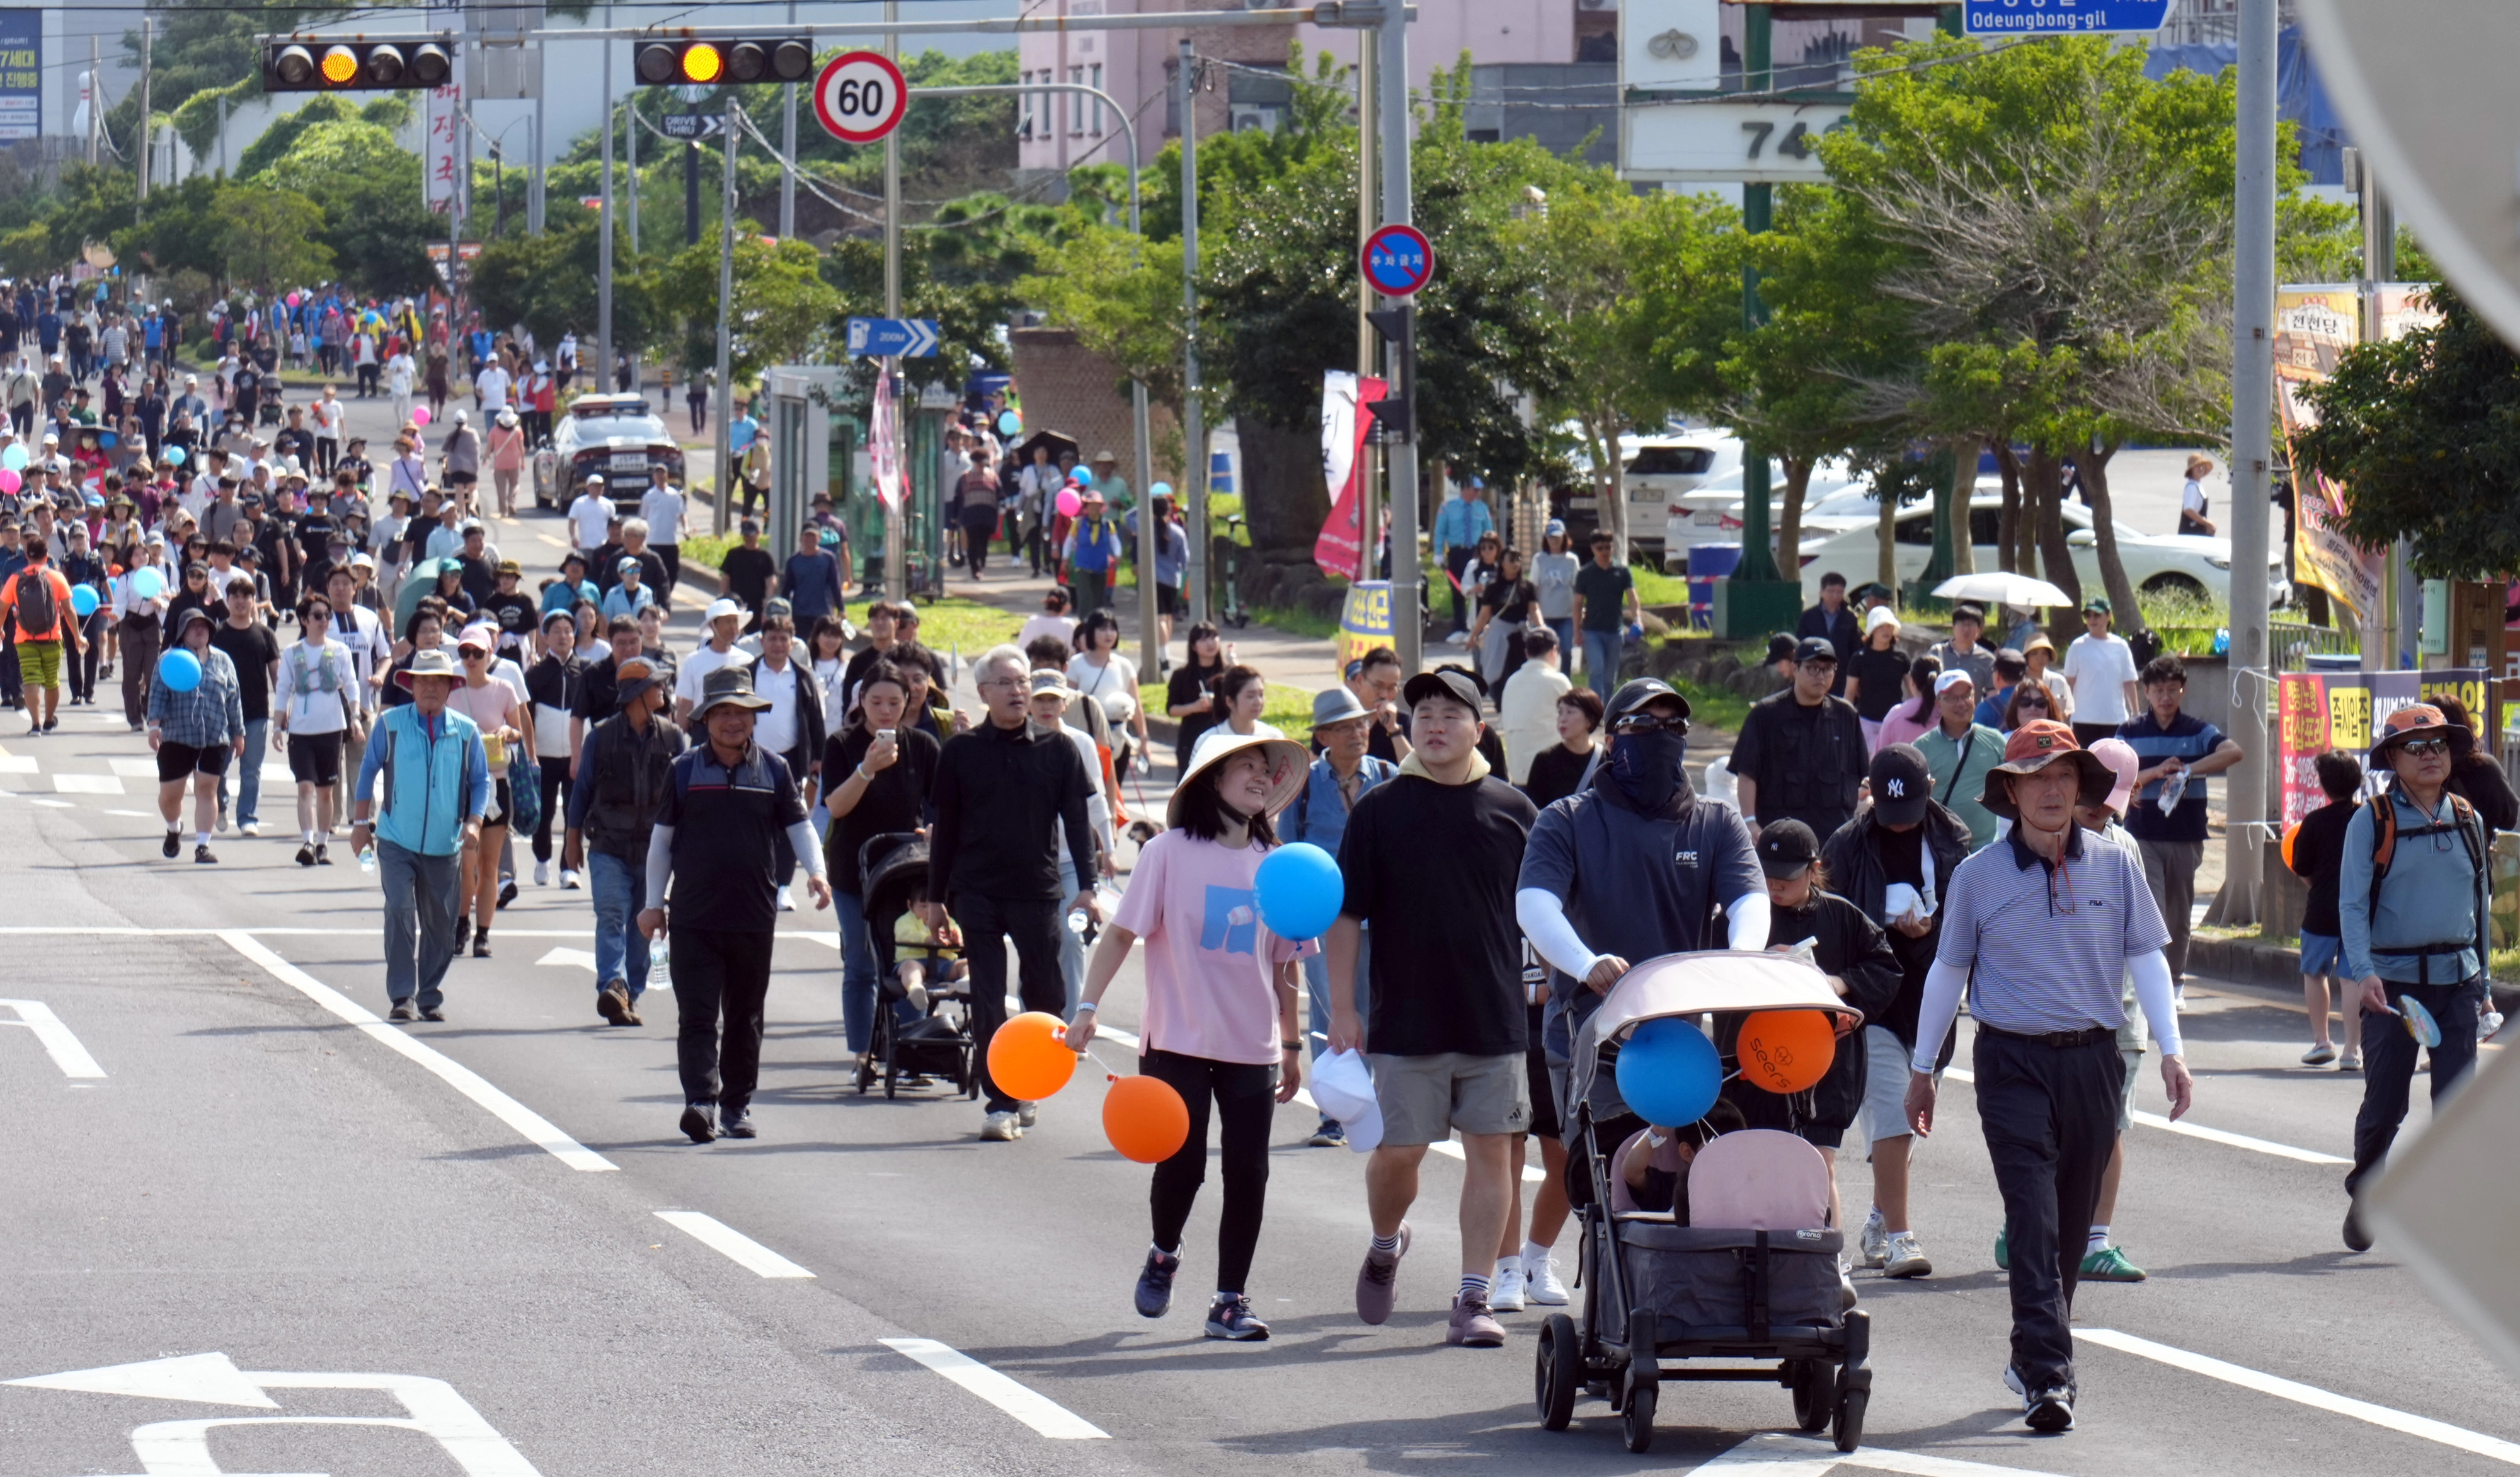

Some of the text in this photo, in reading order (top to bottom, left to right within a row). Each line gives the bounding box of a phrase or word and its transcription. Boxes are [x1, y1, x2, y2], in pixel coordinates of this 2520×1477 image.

[1973, 11, 2106, 30] Odeungbong-gil
[839, 79, 883, 117] 60
[665, 115, 697, 125] DRIVE
[667, 125, 695, 135] THRU
[2332, 695, 2369, 739] 즉시입주
[1887, 778, 1904, 798] NY
[1676, 851, 1698, 861] FRC
[1750, 1038, 1792, 1088] seers
